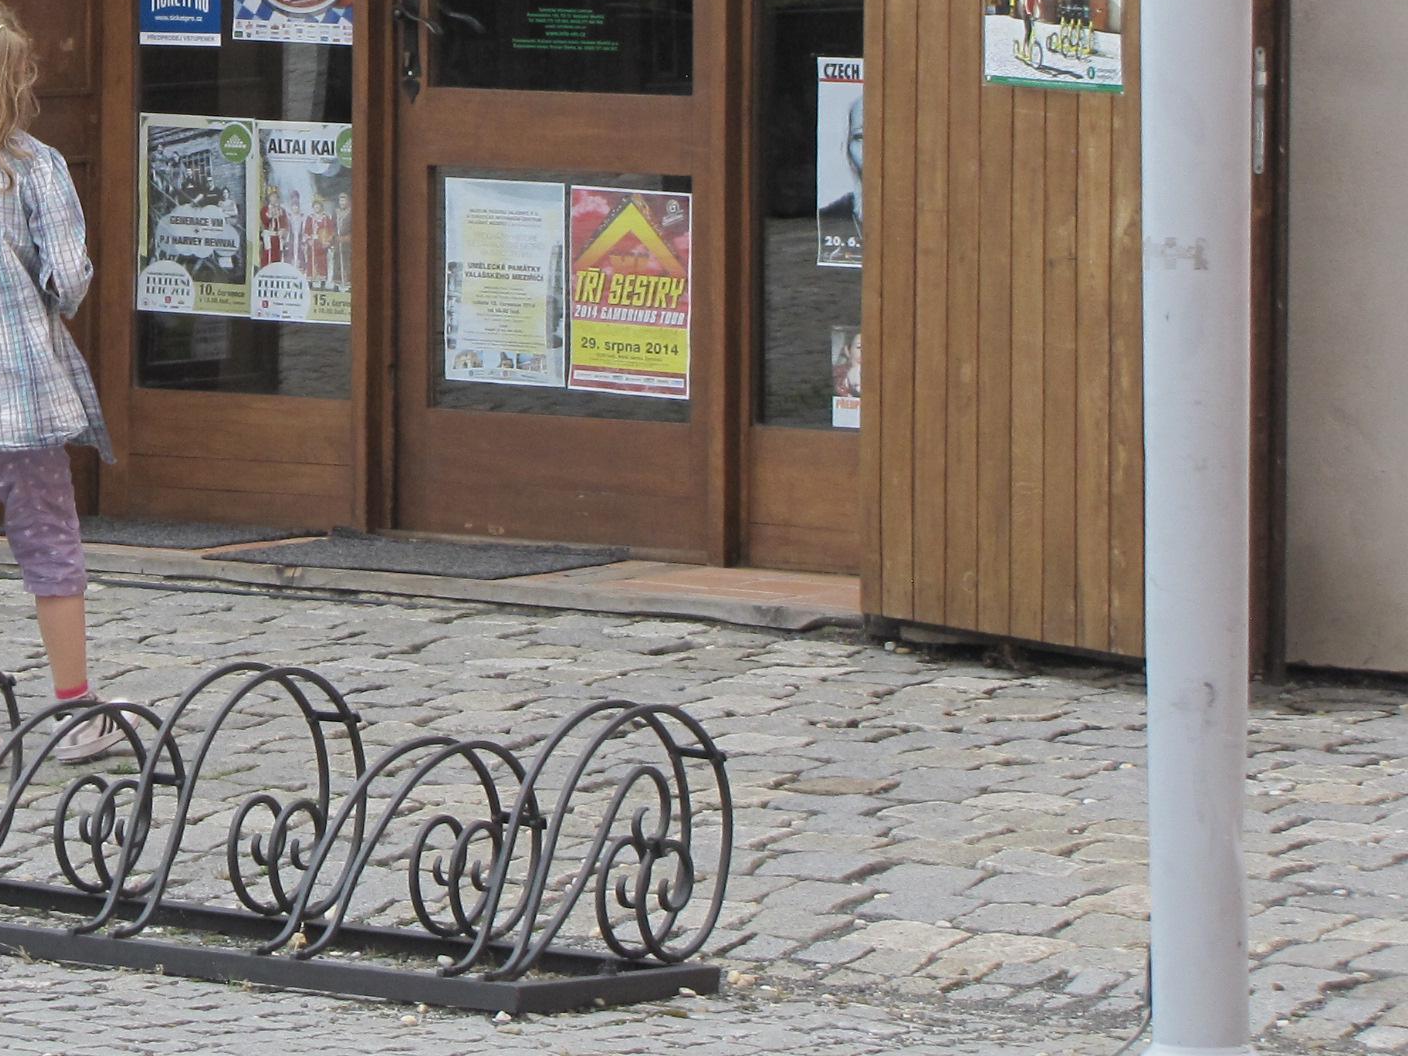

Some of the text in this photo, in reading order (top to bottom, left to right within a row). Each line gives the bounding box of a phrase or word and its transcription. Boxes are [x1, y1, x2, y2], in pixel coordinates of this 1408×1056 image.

[823, 62, 860, 80] CZECH
[268, 138, 306, 155] ALTAI
[824, 236, 845, 247] 20.
[608, 273, 685, 309] SESTRY
[574, 305, 685, 325] 2014 GAMBRINUS TOUR
[580, 336, 679, 355] 29. srpna 2014
